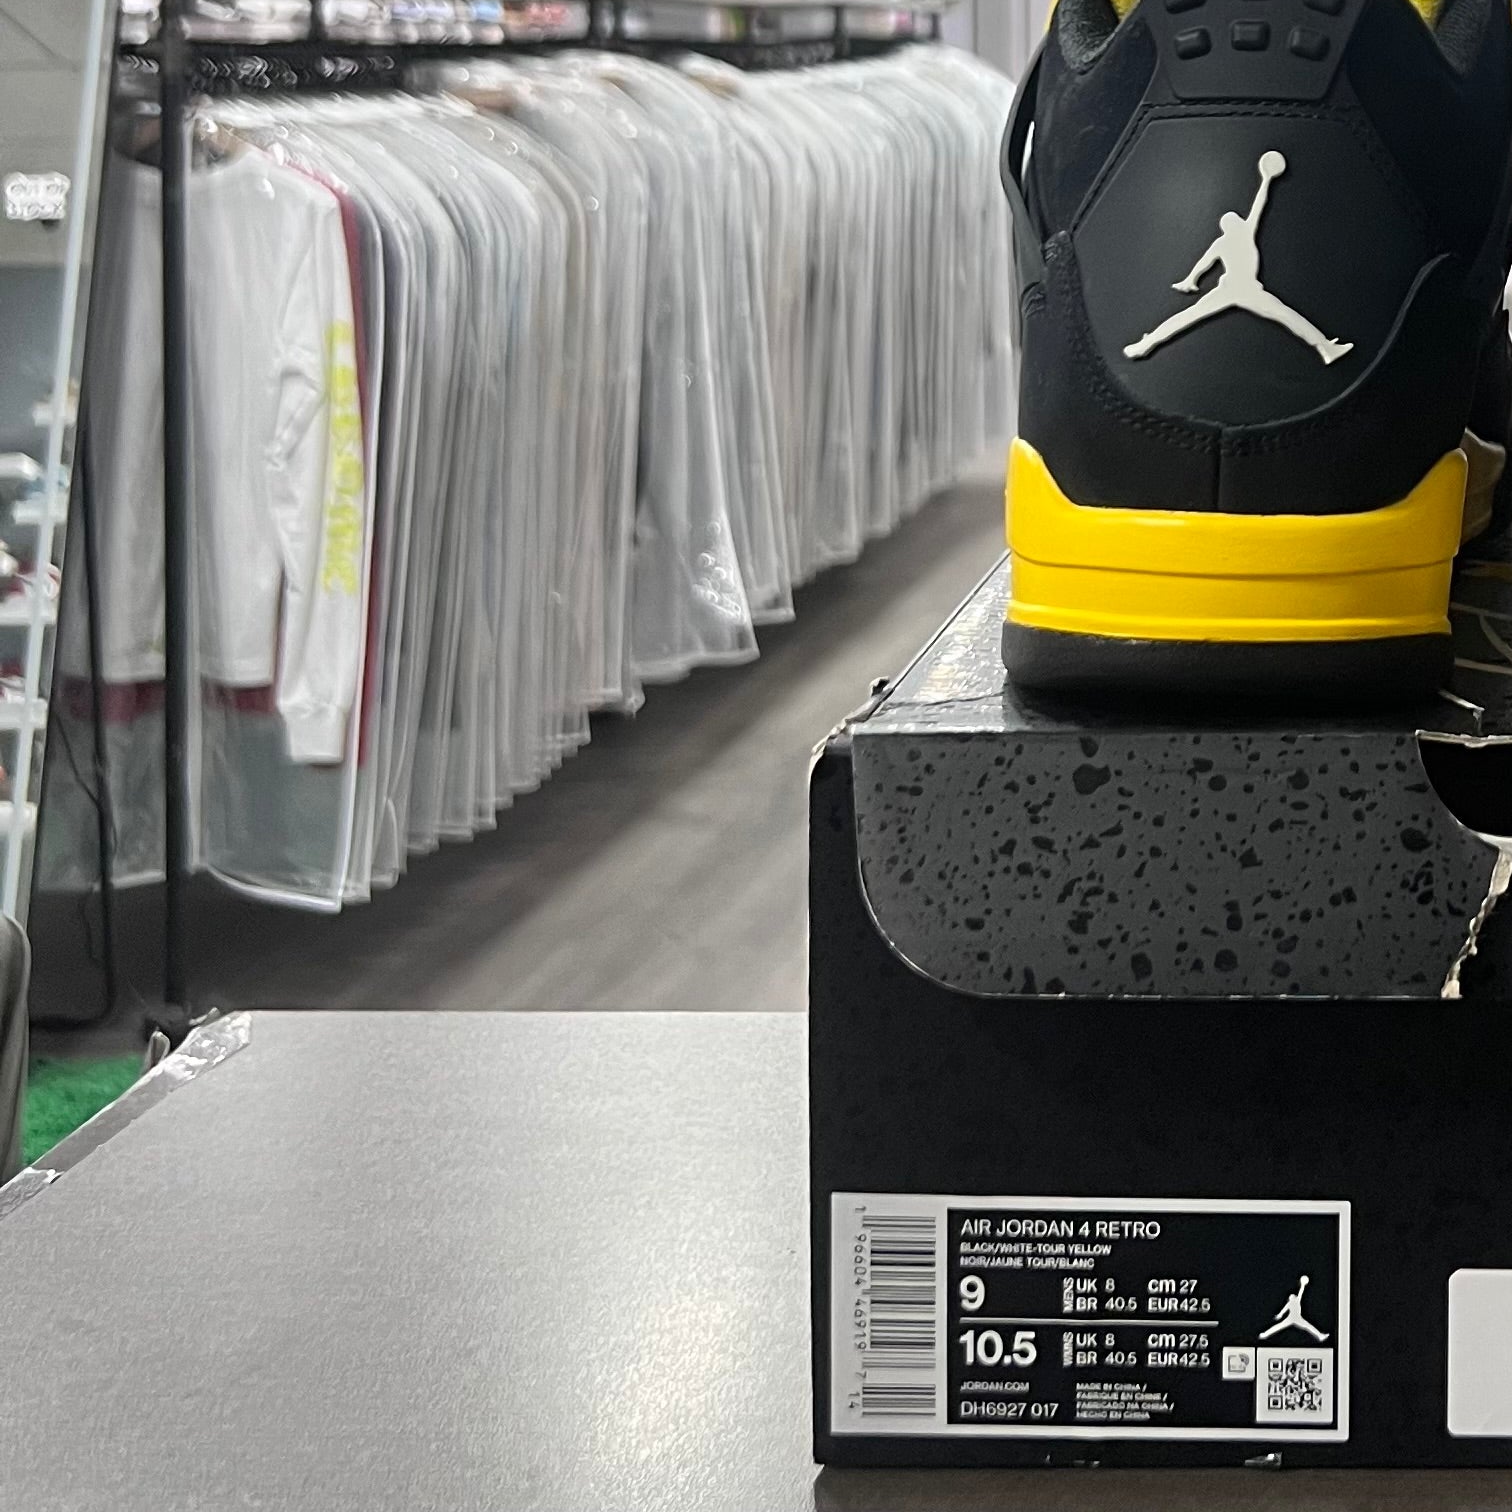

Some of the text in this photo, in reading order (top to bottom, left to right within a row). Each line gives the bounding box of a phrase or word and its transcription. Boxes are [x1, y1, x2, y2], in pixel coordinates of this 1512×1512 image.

[960, 1219, 1161, 1239] AIR JORDAN 4 RETRO
[960, 1242, 1112, 1256] BLACK/WHITE-TOUR YELLOW
[960, 1256, 1095, 1269] NOIR/JAUNE TOUR/BLANC
[959, 1275, 986, 1311] 9
[1076, 1278, 1198, 1294] UK 8 cm 27
[1076, 1297, 1098, 1311] BR
[958, 1329, 1038, 1367] 10.5
[1076, 1333, 1098, 1348] UK
[1105, 1333, 1115, 1347] 8
[1148, 1333, 1176, 1349] cm
[1076, 1351, 1098, 1366] BR
[960, 1381, 1030, 1392] JORDAN.COM
[960, 1401, 1059, 1418] DH6927 017
